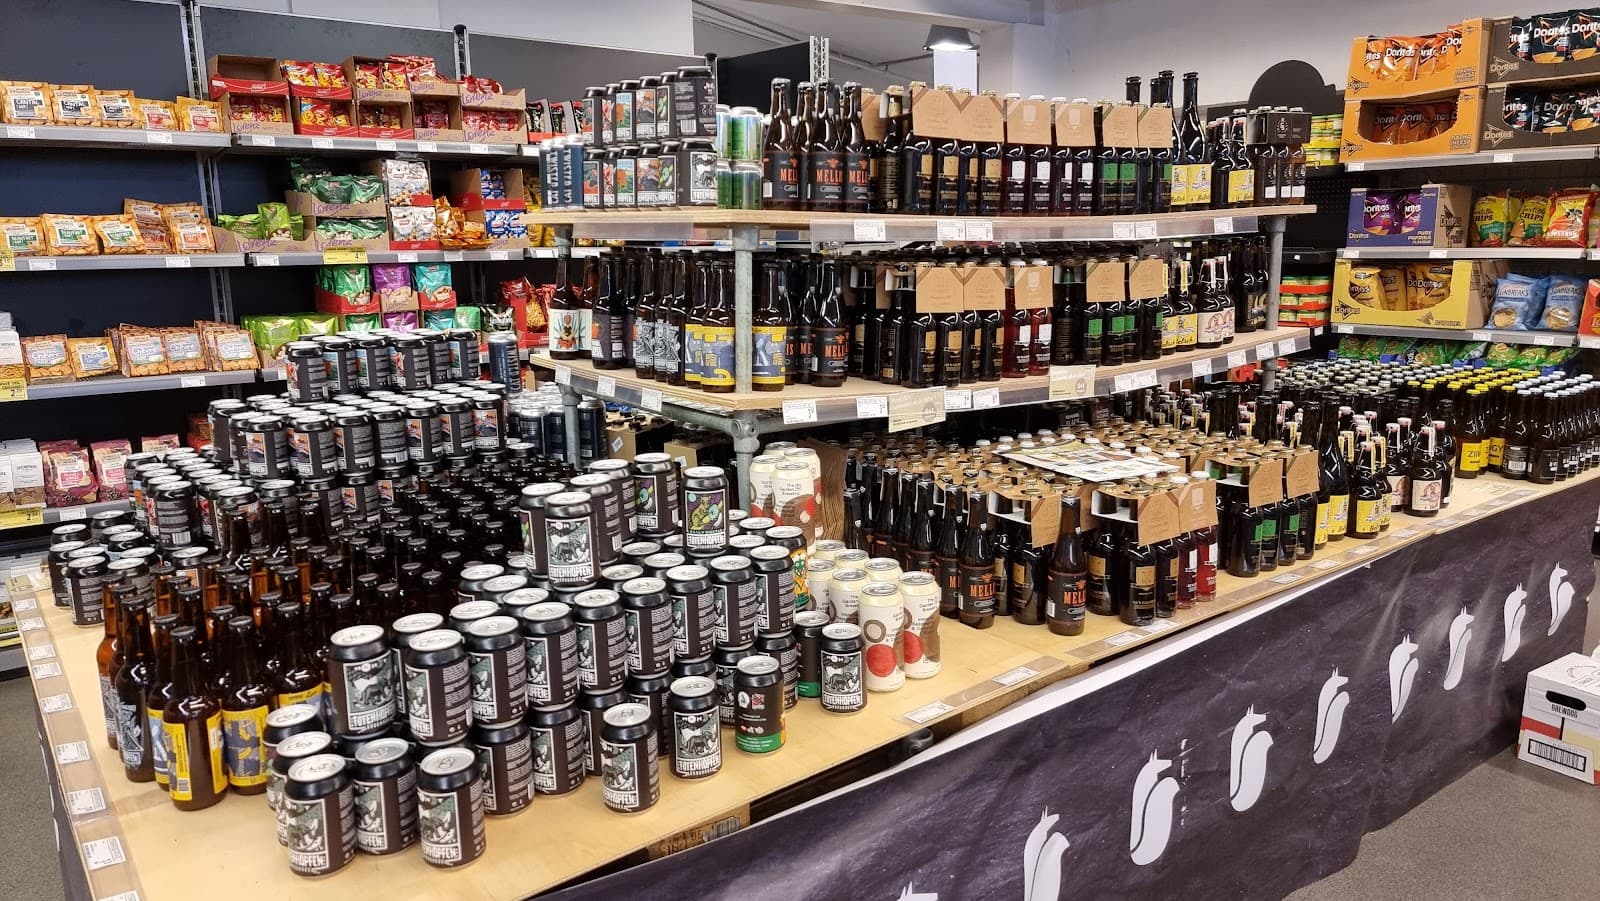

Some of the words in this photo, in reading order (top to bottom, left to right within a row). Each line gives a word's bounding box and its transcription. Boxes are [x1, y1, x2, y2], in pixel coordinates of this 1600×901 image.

[1534, 27, 1570, 38] Doritos
[1386, 47, 1415, 57] Doritos
[1490, 62, 1519, 72] Doritos
[1484, 130, 1514, 139] Doritos
[1519, 212, 1545, 222] CHIPS
[1335, 306, 1360, 314] Doritos
[1551, 703, 1579, 719] BREWDOG
